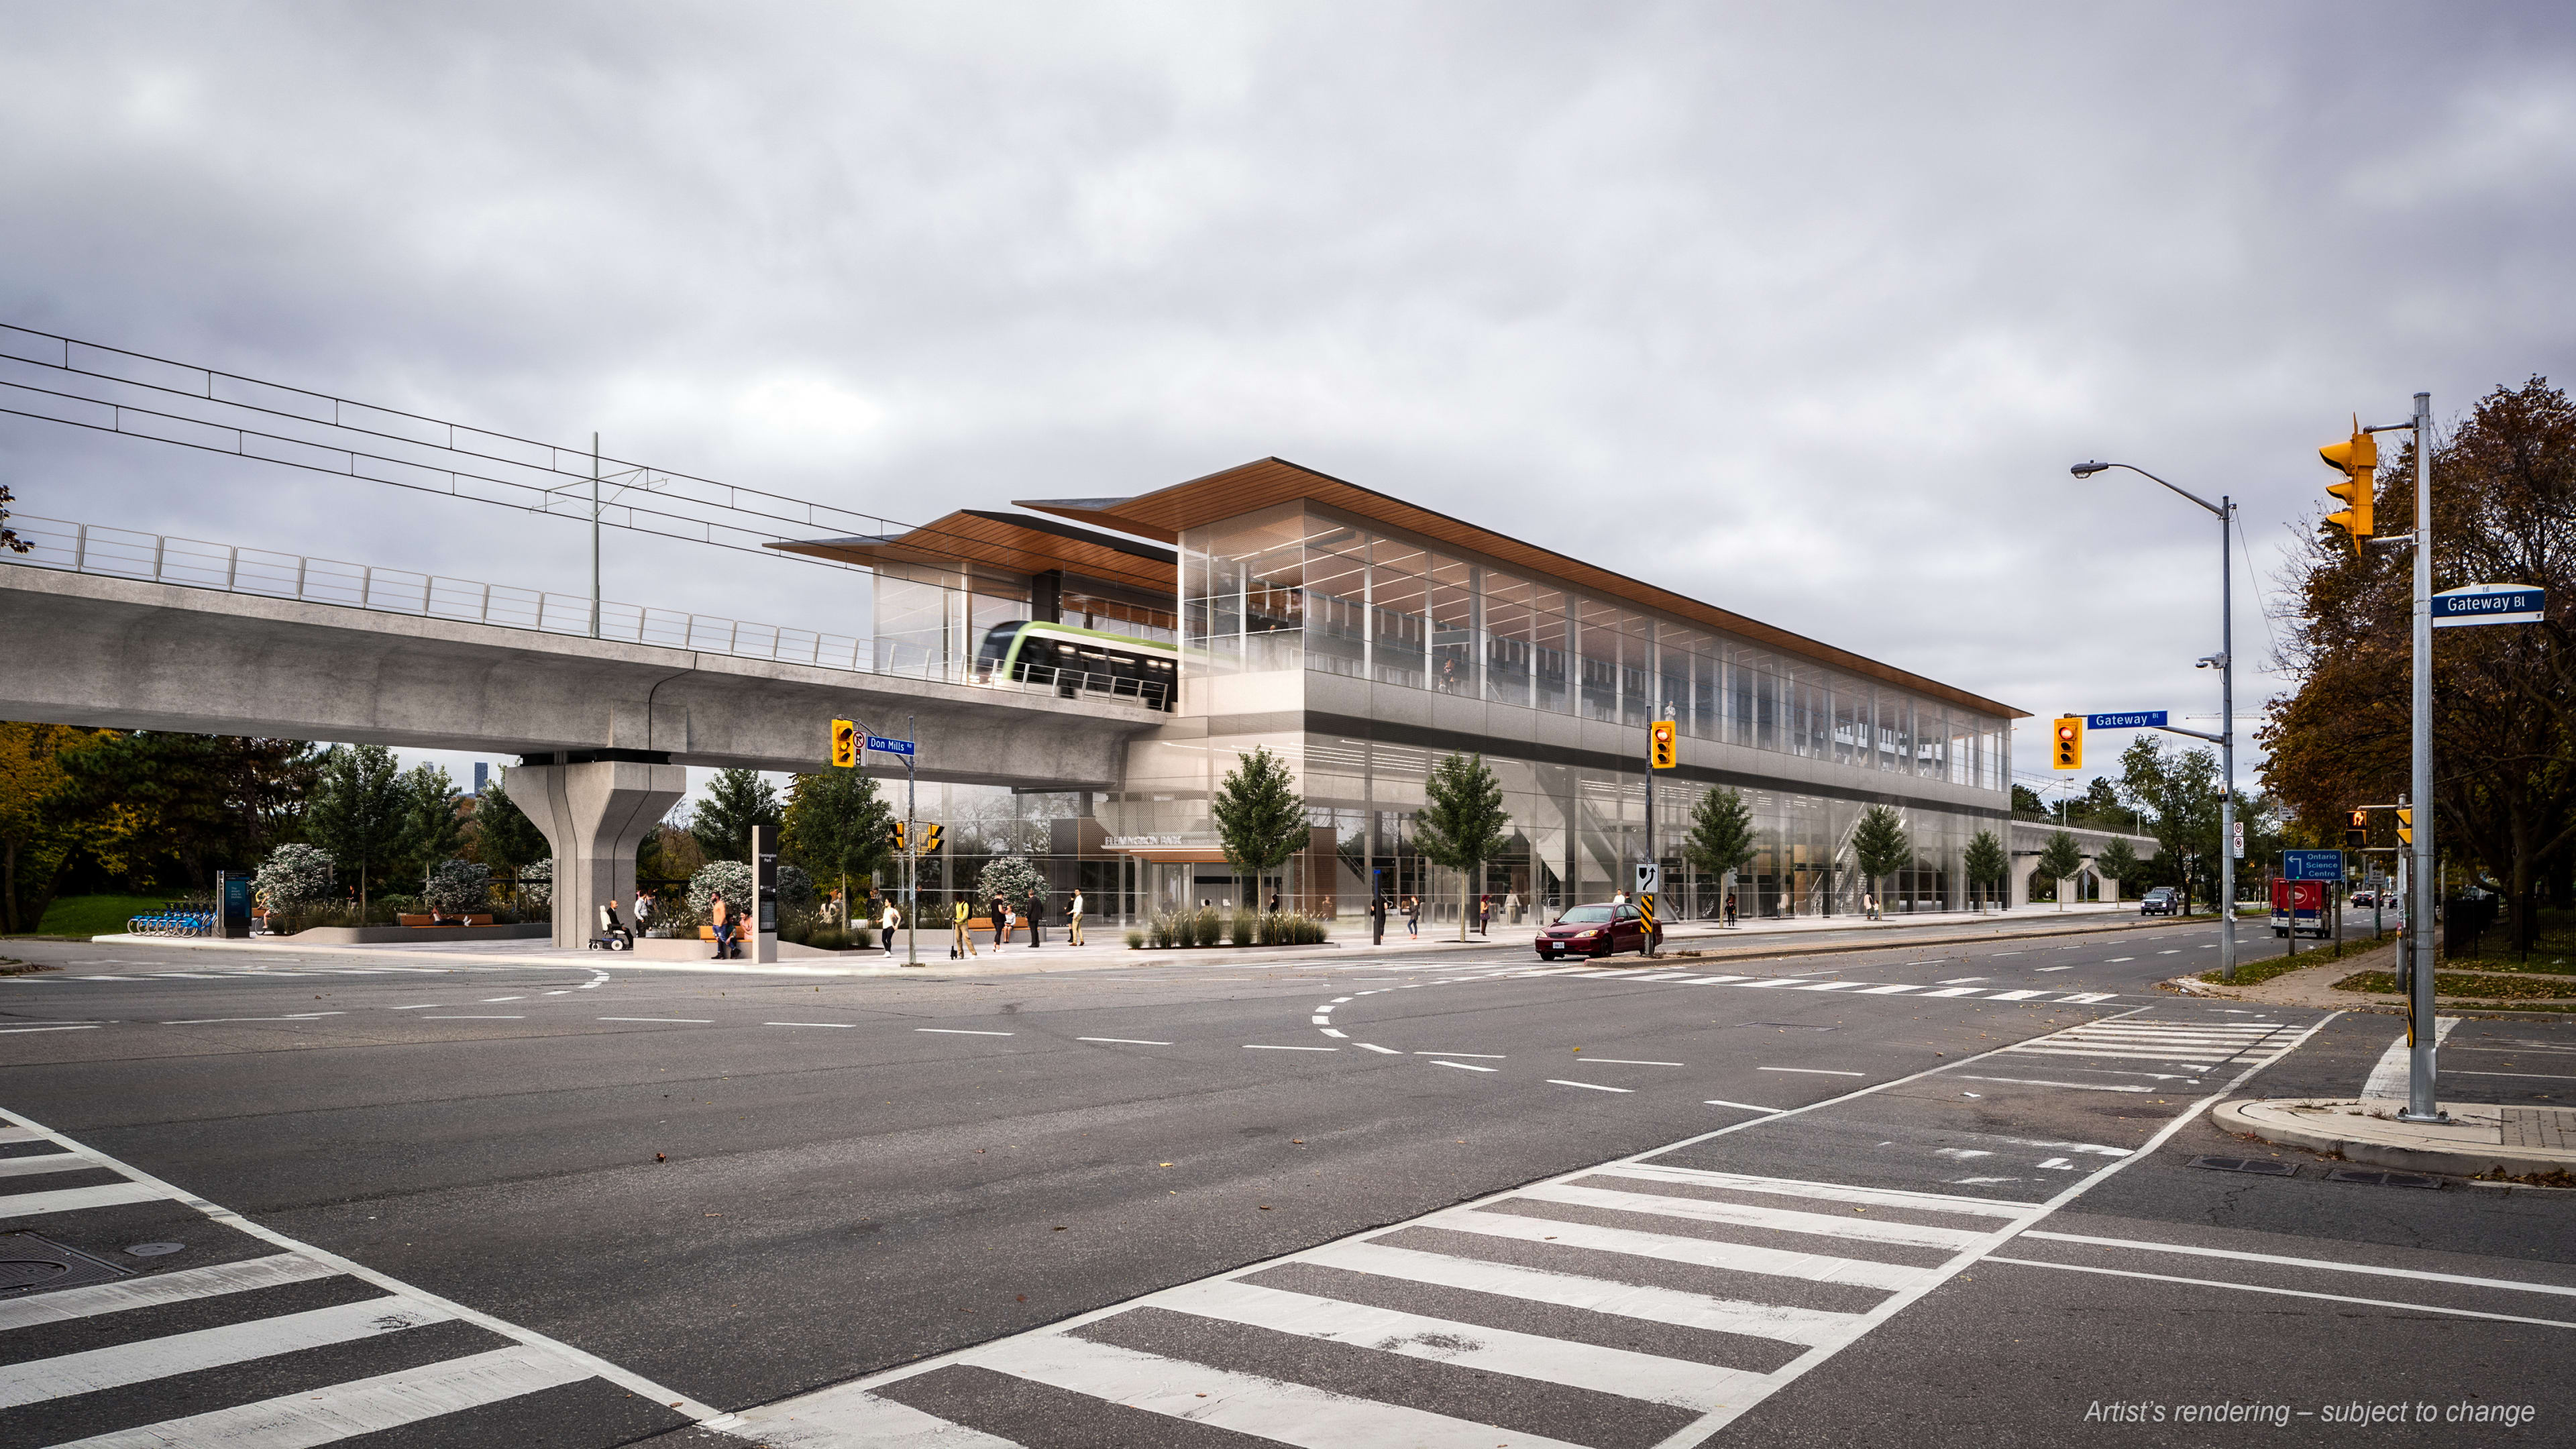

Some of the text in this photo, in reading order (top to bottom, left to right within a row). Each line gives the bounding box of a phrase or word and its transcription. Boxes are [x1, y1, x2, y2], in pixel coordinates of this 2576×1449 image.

[2448, 596, 2526, 612] Gateway Bl
[2096, 715, 2147, 727] Gateway
[871, 738, 885, 749] Don
[888, 740, 904, 751] Mills
